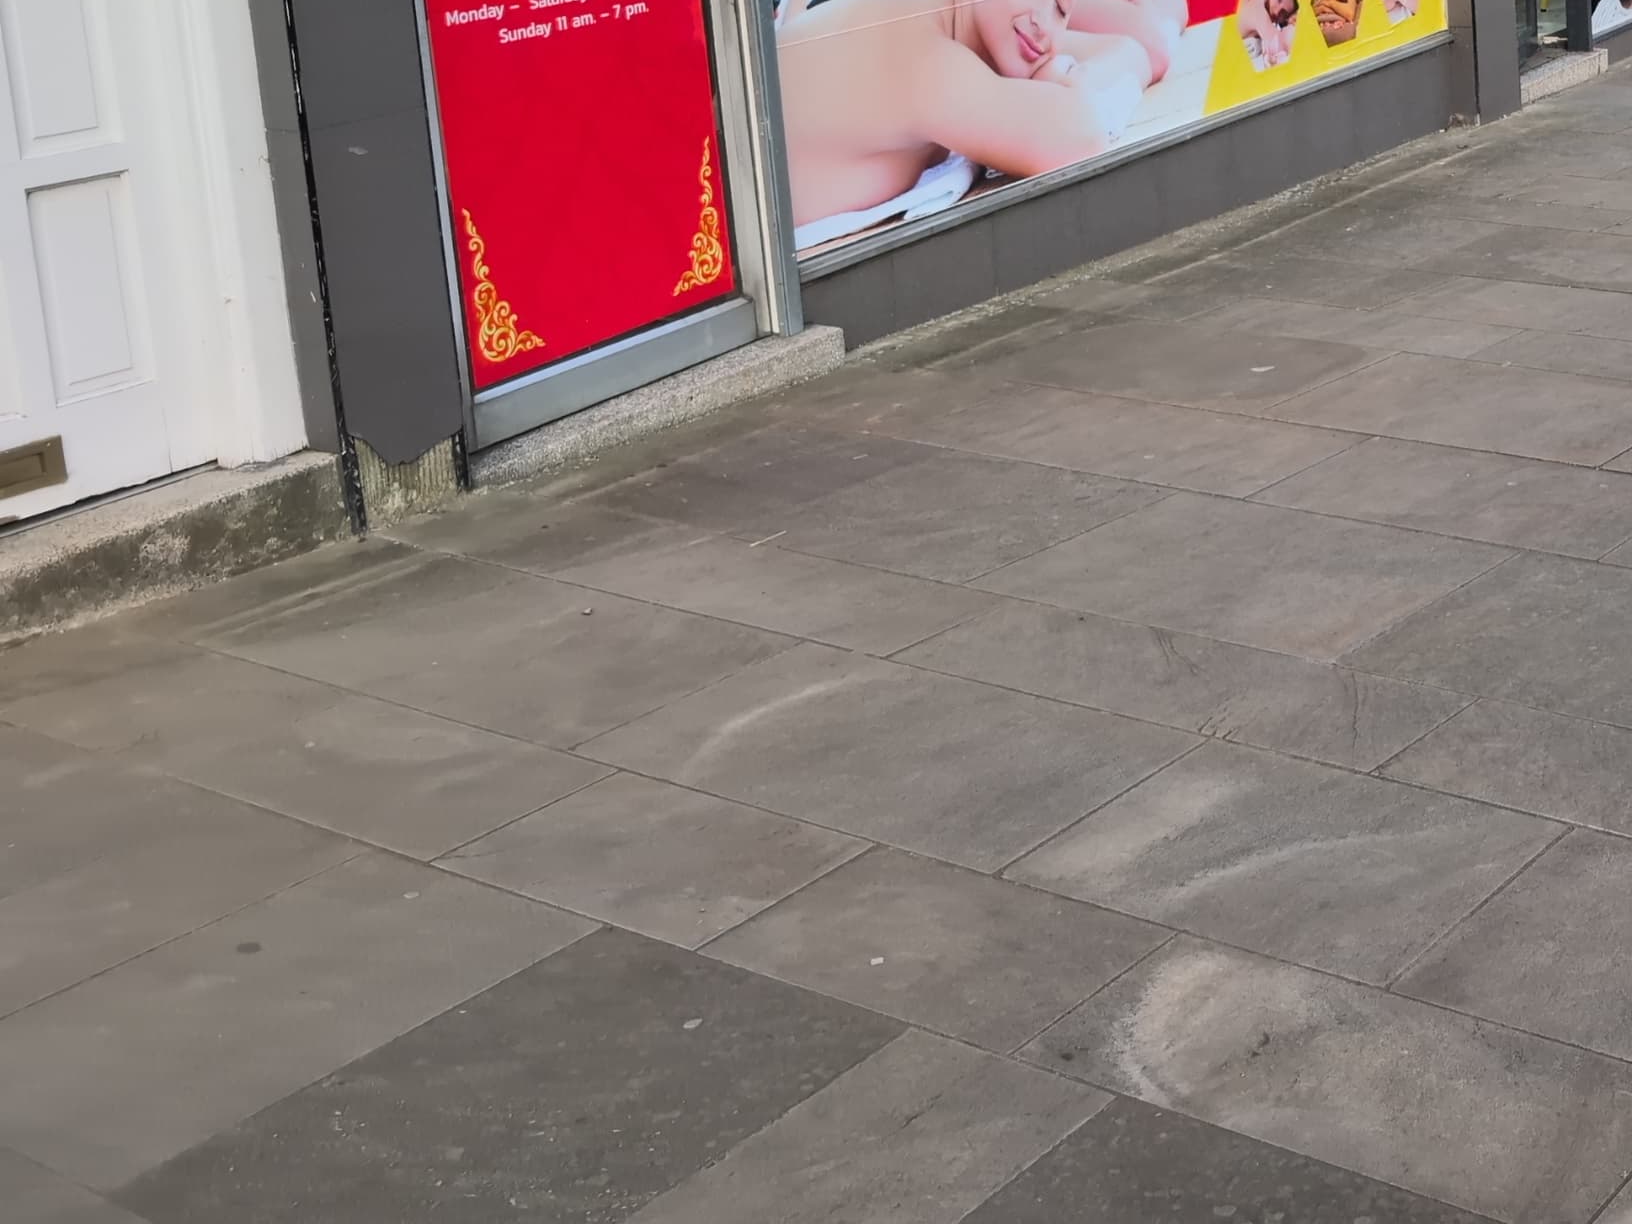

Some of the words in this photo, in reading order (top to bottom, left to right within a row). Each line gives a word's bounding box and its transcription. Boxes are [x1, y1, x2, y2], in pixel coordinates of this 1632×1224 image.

[446, 3, 505, 27] Monday
[499, 21, 553, 44] Sunday
[556, 16, 568, 31] 11
[572, 12, 597, 29] am.
[612, 5, 622, 19] 7
[625, 1, 650, 21] pm.
